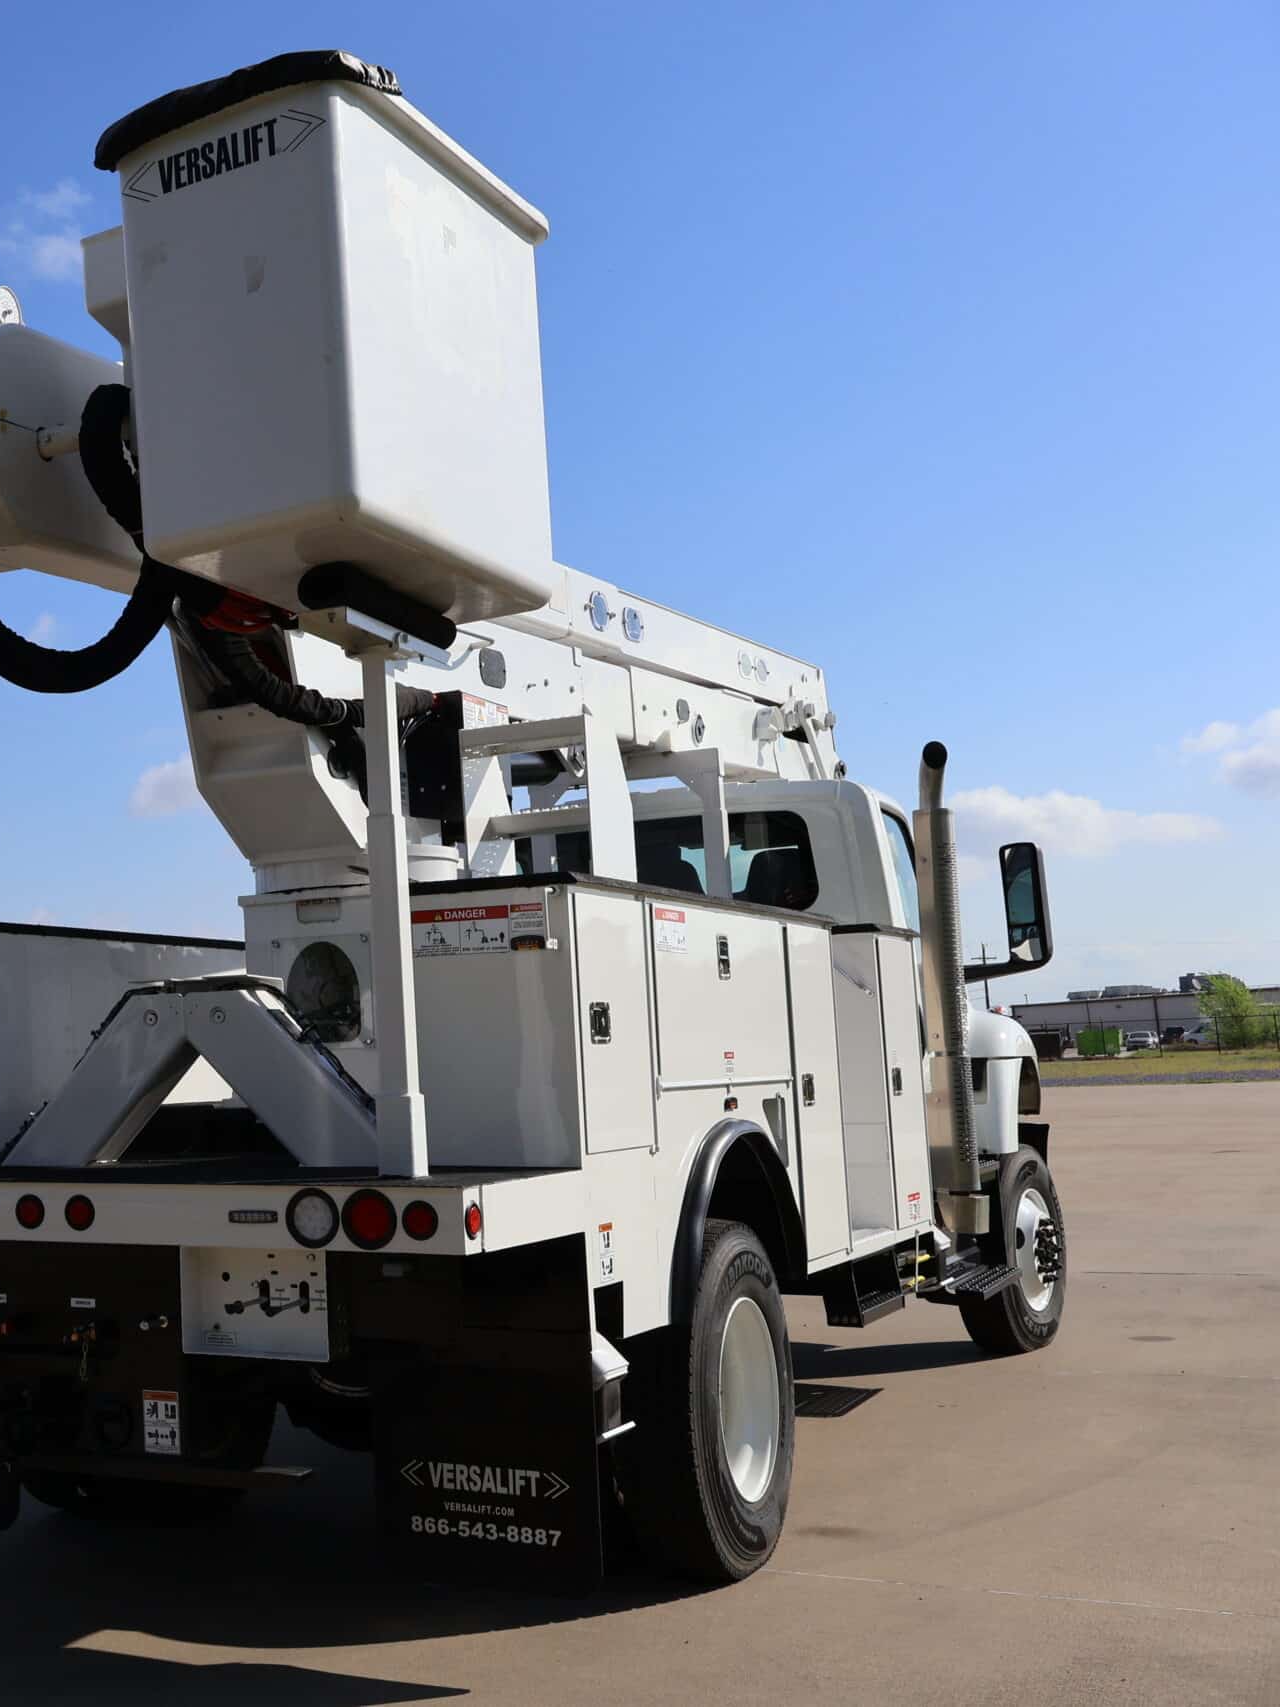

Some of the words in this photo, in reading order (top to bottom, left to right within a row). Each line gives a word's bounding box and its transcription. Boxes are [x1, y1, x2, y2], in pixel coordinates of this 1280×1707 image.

[158, 118, 277, 195] VERSALIFT
[444, 908, 487, 920] DANGER
[428, 1461, 541, 1498] VERSALIFT
[444, 1501, 516, 1517] VERSALIFT.COM
[410, 1514, 562, 1547] 866-543-8887
